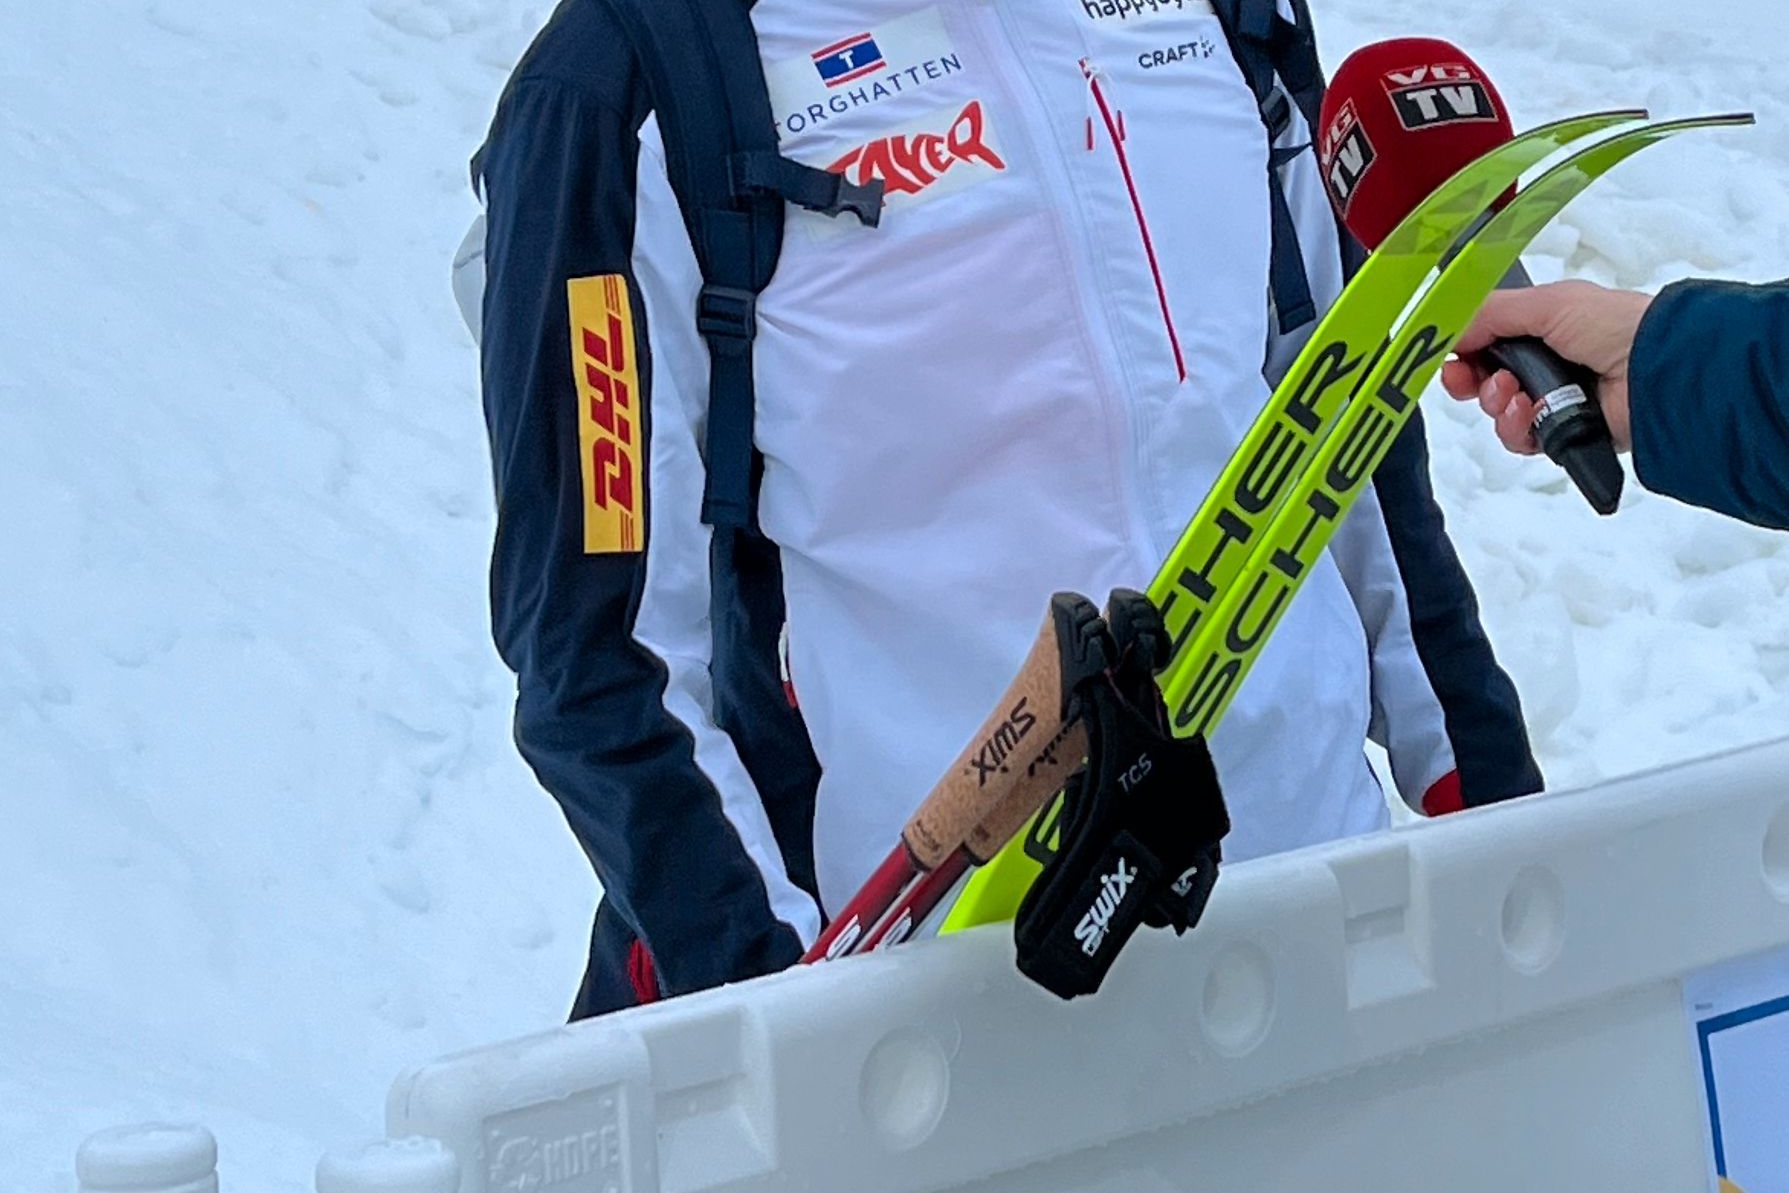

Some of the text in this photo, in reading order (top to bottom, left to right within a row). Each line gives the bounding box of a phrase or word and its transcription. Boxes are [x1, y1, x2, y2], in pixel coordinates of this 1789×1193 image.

[1138, 42, 1198, 69] CRAFT
[1385, 65, 1471, 85] VG
[774, 53, 963, 133] ORGHATTEN
[1406, 85, 1478, 120] TV
[1331, 134, 1363, 198] TV
[583, 312, 633, 513] DHL
[1175, 324, 1455, 734] SCHER
[1117, 753, 1152, 792] TCS
